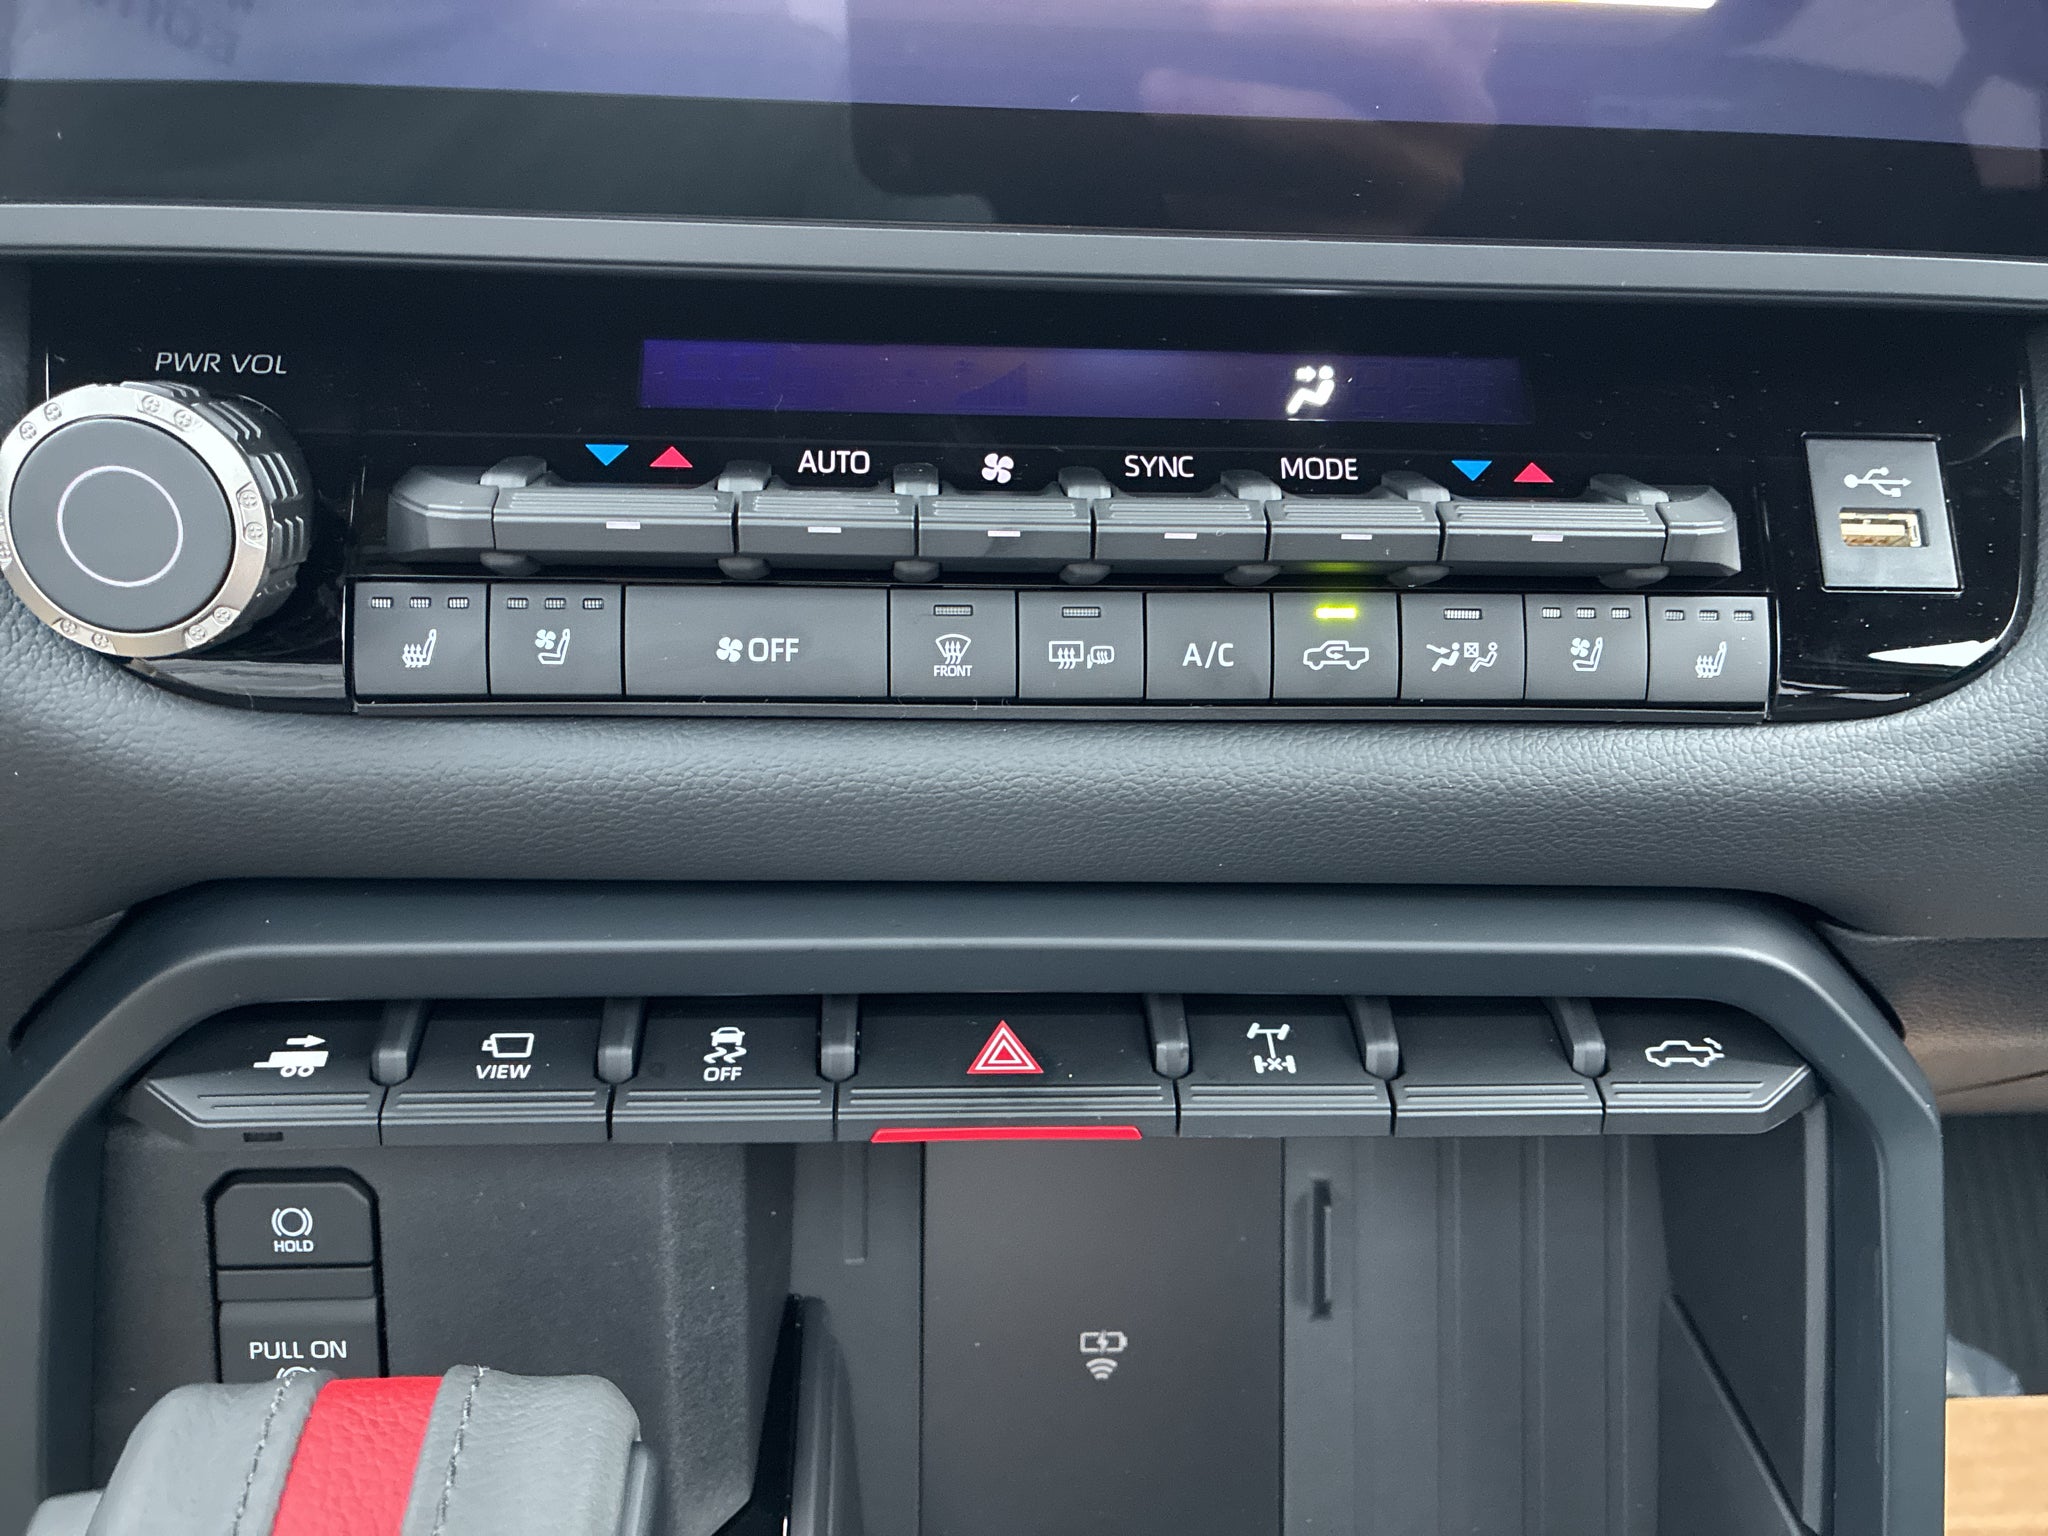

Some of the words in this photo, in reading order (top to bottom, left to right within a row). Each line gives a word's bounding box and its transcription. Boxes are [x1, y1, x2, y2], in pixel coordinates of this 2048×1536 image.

[155, 352, 221, 373] PWR
[231, 354, 287, 374] VOL
[797, 449, 871, 475] AUTO
[1124, 454, 1195, 478] SYNC
[1280, 456, 1359, 481] MODE
[747, 637, 800, 662] OFF
[1182, 641, 1235, 669] A/C
[933, 664, 973, 677] FRONT
[475, 1064, 532, 1080] VIEW
[703, 1066, 743, 1082] OFF
[273, 1239, 314, 1253] HOLD
[249, 1341, 305, 1360] PULL
[310, 1340, 347, 1359] ON
